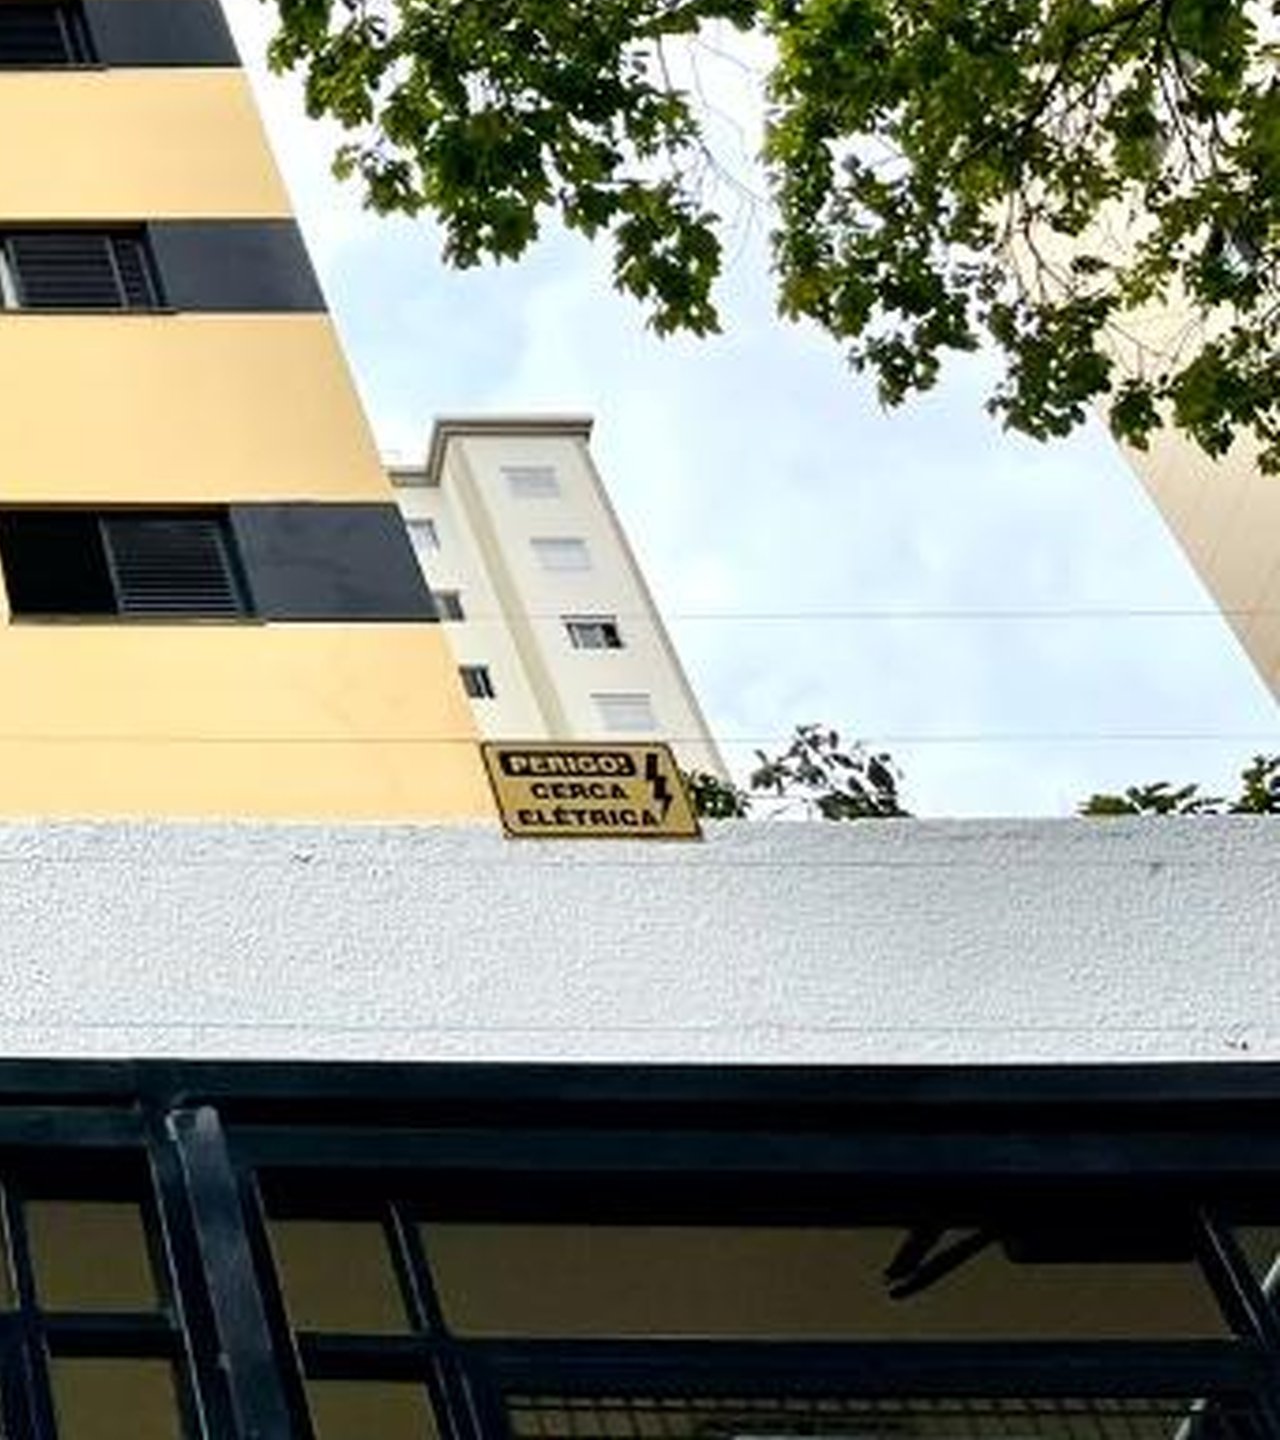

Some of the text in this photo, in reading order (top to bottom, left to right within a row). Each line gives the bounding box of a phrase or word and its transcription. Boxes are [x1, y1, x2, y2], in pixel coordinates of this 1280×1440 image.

[508, 755, 631, 774] PERIGO!
[531, 782, 629, 800] CERCA
[517, 806, 657, 826] ELÉTRICA
